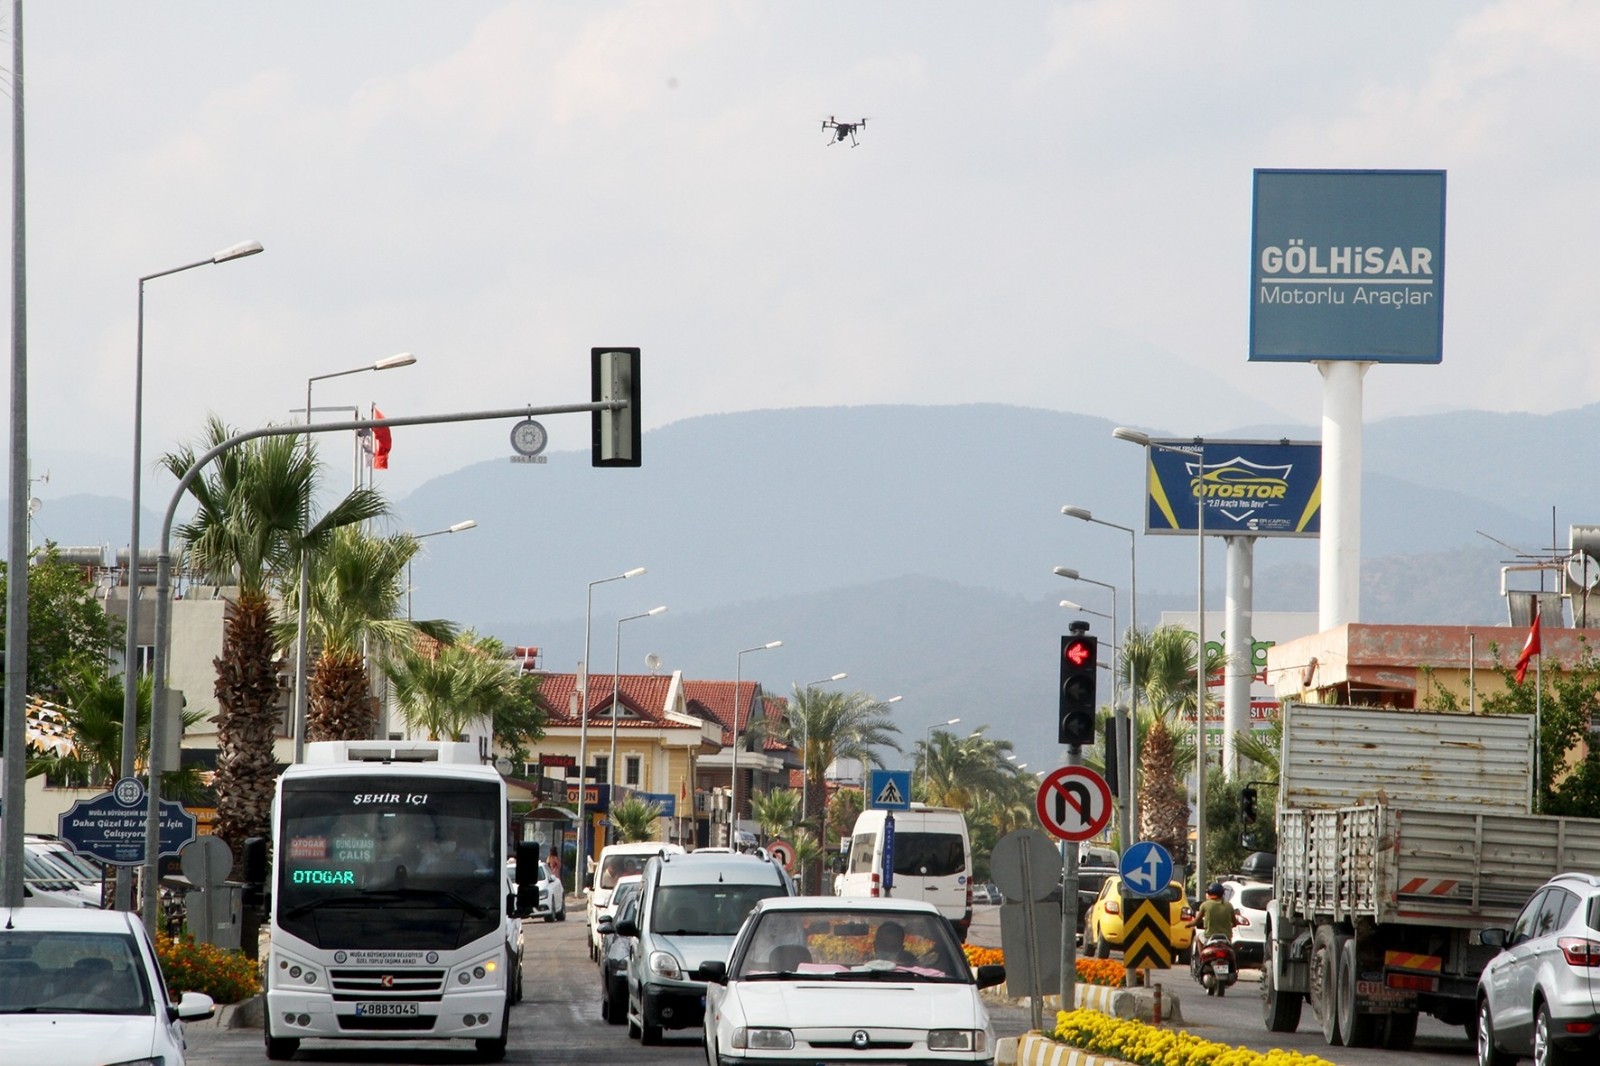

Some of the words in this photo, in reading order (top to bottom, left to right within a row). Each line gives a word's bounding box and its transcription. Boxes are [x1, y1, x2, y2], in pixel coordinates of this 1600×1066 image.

[1261, 286, 1345, 305] Motorlu
[1353, 287, 1433, 310] Araçlar
[1193, 485, 1287, 499] OTOSTOR
[1220, 500, 1238, 509] Araçta
[353, 792, 400, 804] ŞEHİR
[405, 793, 428, 805] İÇİ
[97, 819, 121, 828] Güzel
[124, 819, 136, 827] Bir
[167, 818, 183, 829] İçin
[104, 829, 147, 839] Çalışıyoru
[291, 839, 325, 848] OTOGAR
[293, 870, 355, 884] OTOGAR
